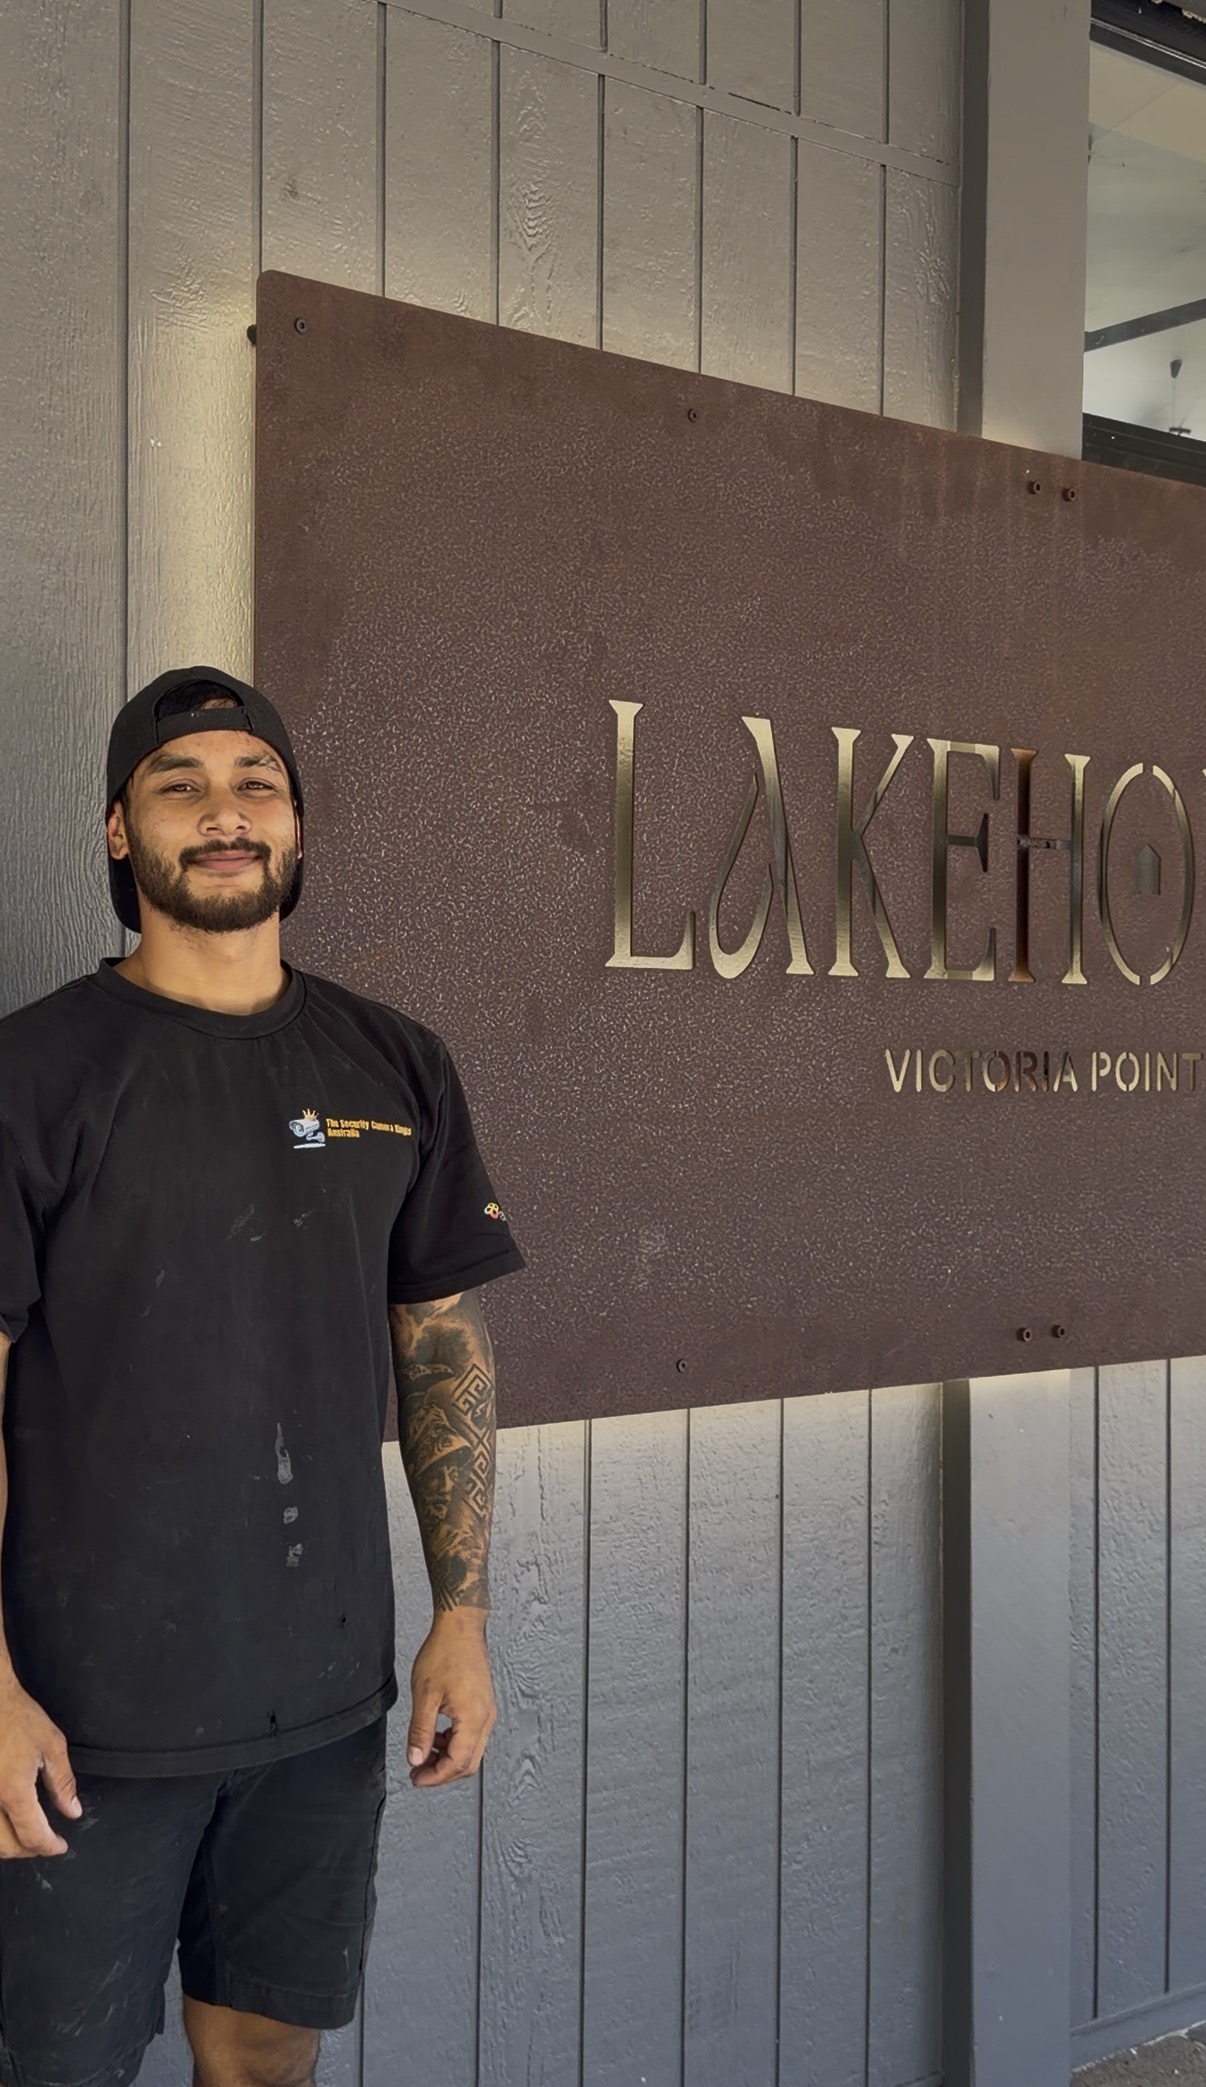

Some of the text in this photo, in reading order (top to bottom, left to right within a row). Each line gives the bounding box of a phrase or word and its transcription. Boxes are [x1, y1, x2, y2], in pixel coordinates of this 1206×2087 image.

[605, 699, 1206, 986] LAKEHO
[884, 1048, 1204, 1093] VICTORIA POINT
[326, 1118, 340, 1128] The
[340, 1119, 369, 1131] Security
[327, 1127, 360, 1138] Australia
